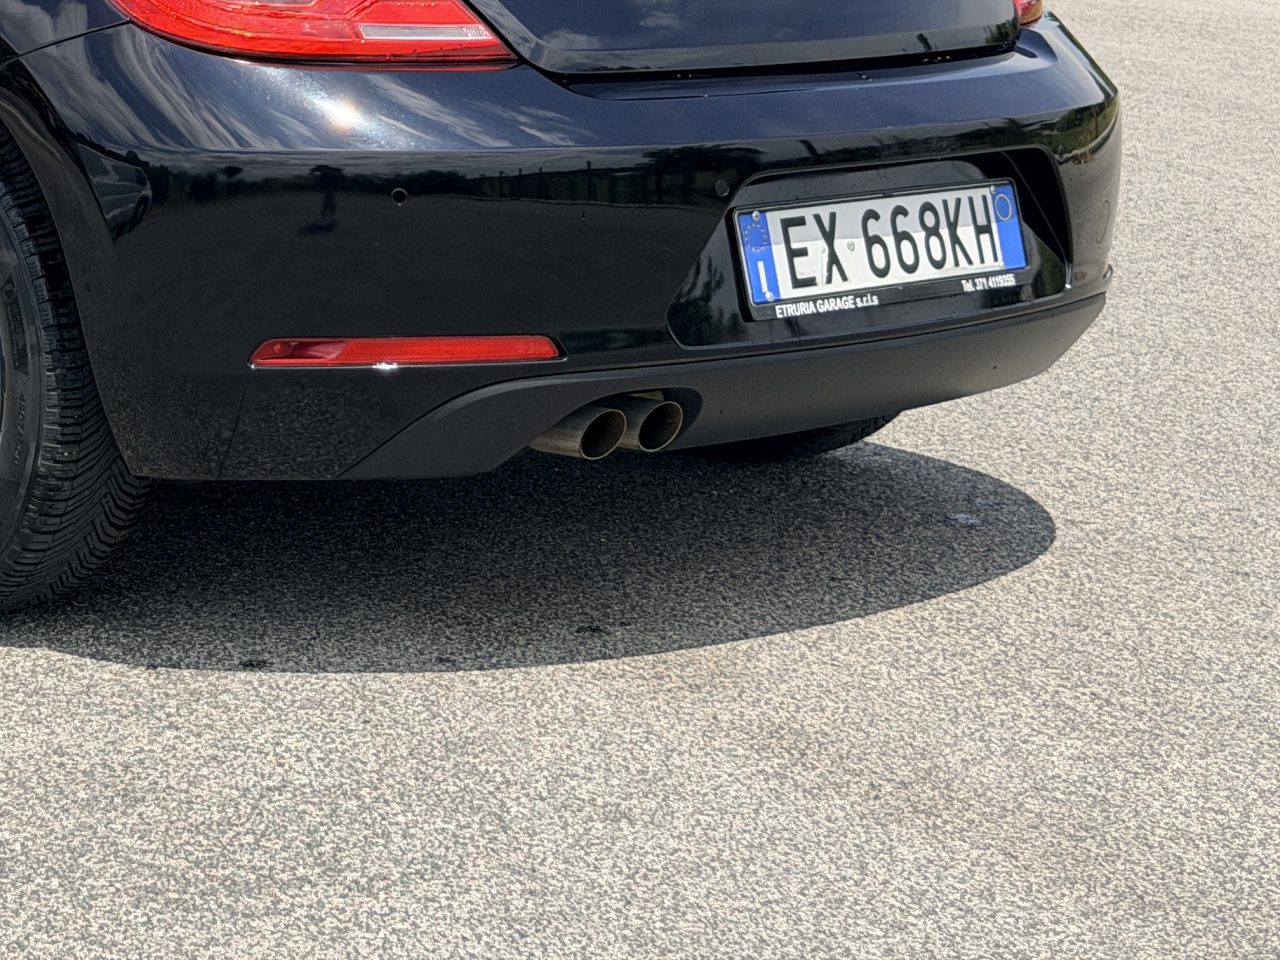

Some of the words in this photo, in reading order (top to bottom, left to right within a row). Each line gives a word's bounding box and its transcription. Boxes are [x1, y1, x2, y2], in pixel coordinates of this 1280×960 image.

[780, 211, 849, 290] EX
[861, 194, 999, 279] 668KH
[961, 278, 976, 293] Tel.
[974, 276, 990, 291] 371
[775, 300, 817, 319] ETRURIA
[816, 295, 856, 313] GARAGE
